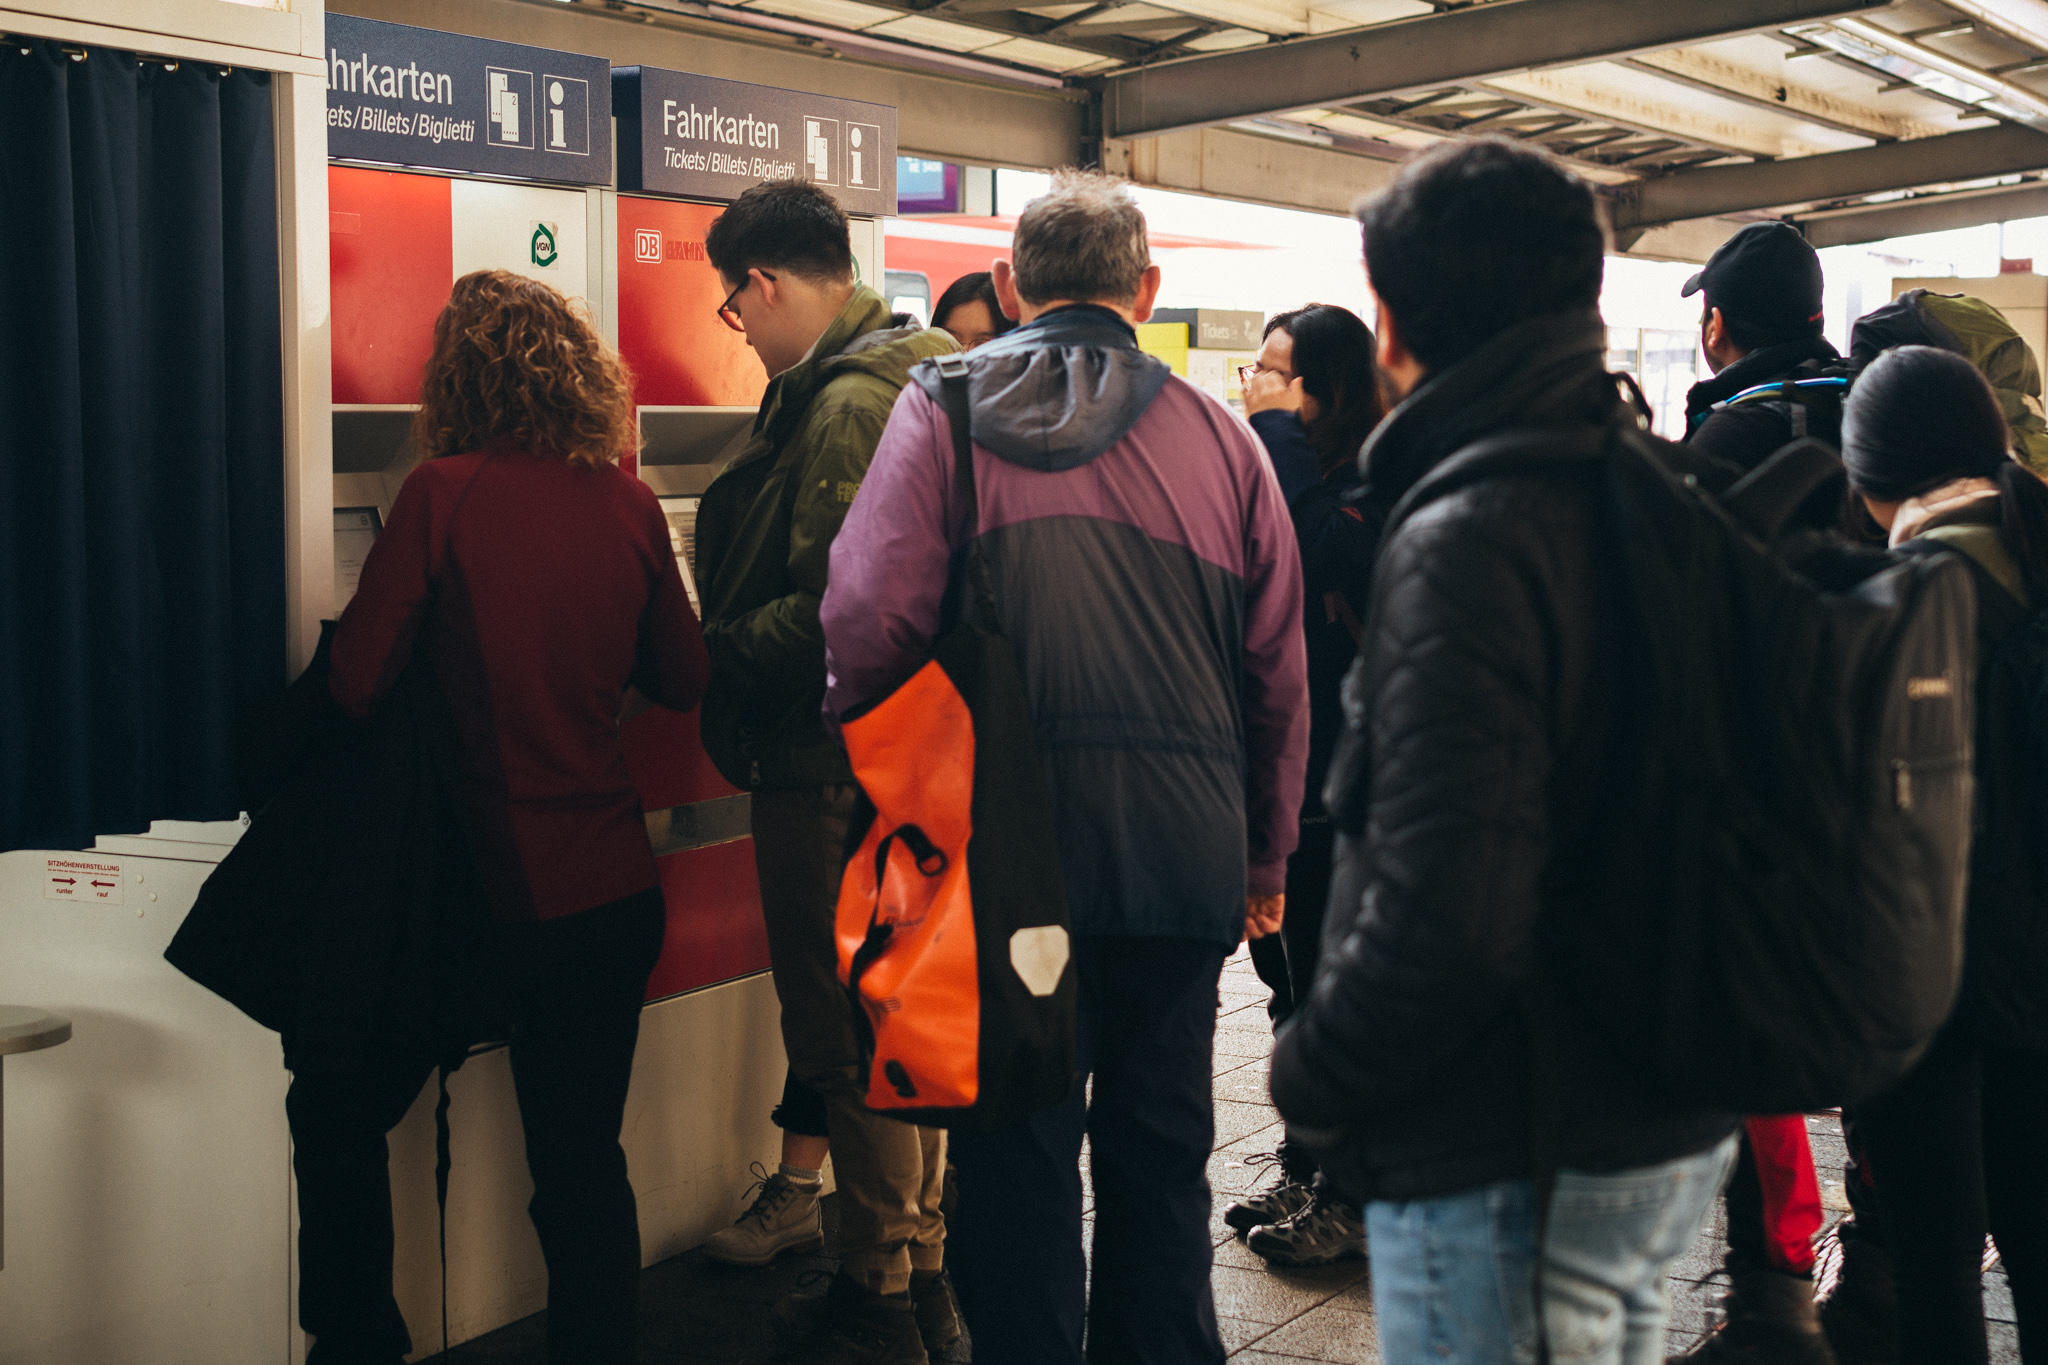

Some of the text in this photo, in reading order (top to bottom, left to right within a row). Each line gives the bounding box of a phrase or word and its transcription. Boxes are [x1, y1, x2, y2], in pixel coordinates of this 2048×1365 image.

[327, 104, 475, 144] ets/Billets/Biglietti
[663, 99, 779, 150] Fahrkarten
[536, 242, 550, 251] VGN
[638, 233, 659, 258] DB
[47, 860, 119, 871] SITZHÖHENVERSTELLUNG
